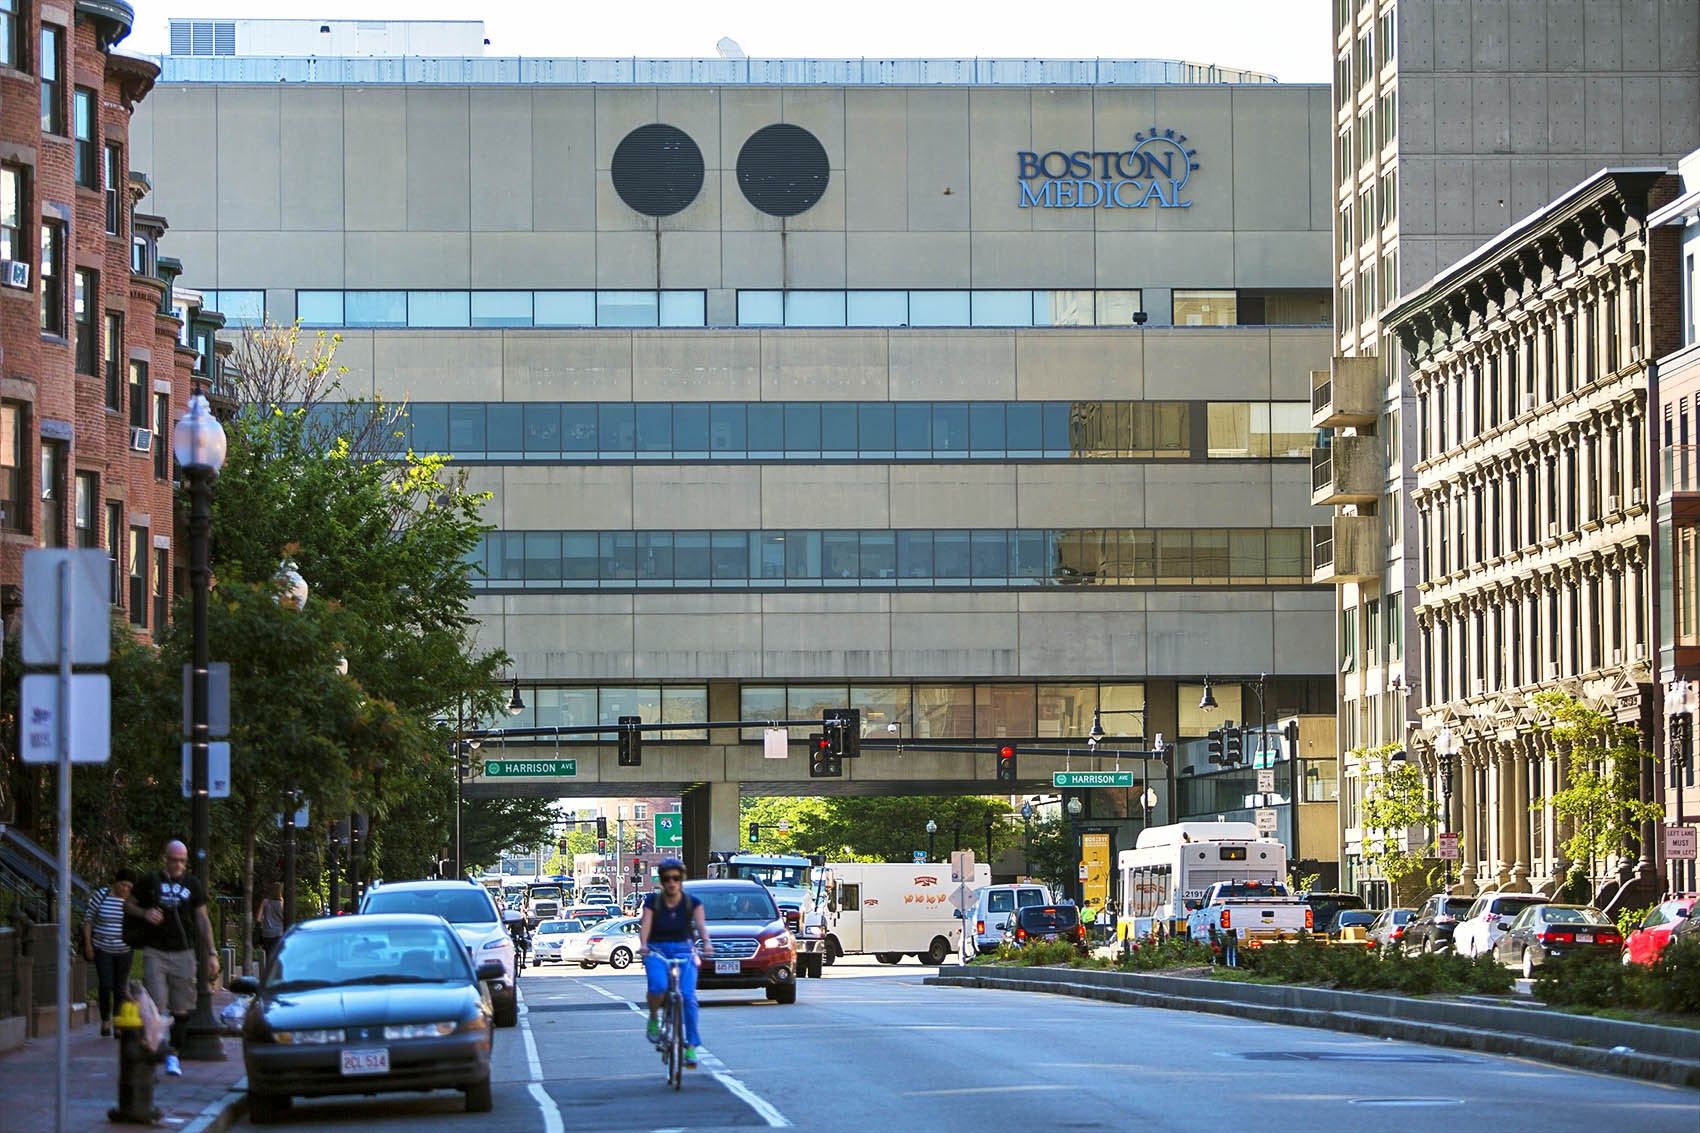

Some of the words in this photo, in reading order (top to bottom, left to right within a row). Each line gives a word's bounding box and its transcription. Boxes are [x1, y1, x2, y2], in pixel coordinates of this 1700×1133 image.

[1134, 127, 1200, 171] CENTER
[1017, 151, 1174, 179] BOSTON
[1018, 179, 1193, 208] MEDICAL
[505, 763, 556, 773] HARRISON
[560, 762, 574, 770] AVE
[1071, 775, 1115, 784] HARRISON
[660, 820, 673, 828] 93
[1672, 839, 1689, 847] MUST
[1185, 890, 1203, 898] 2191
